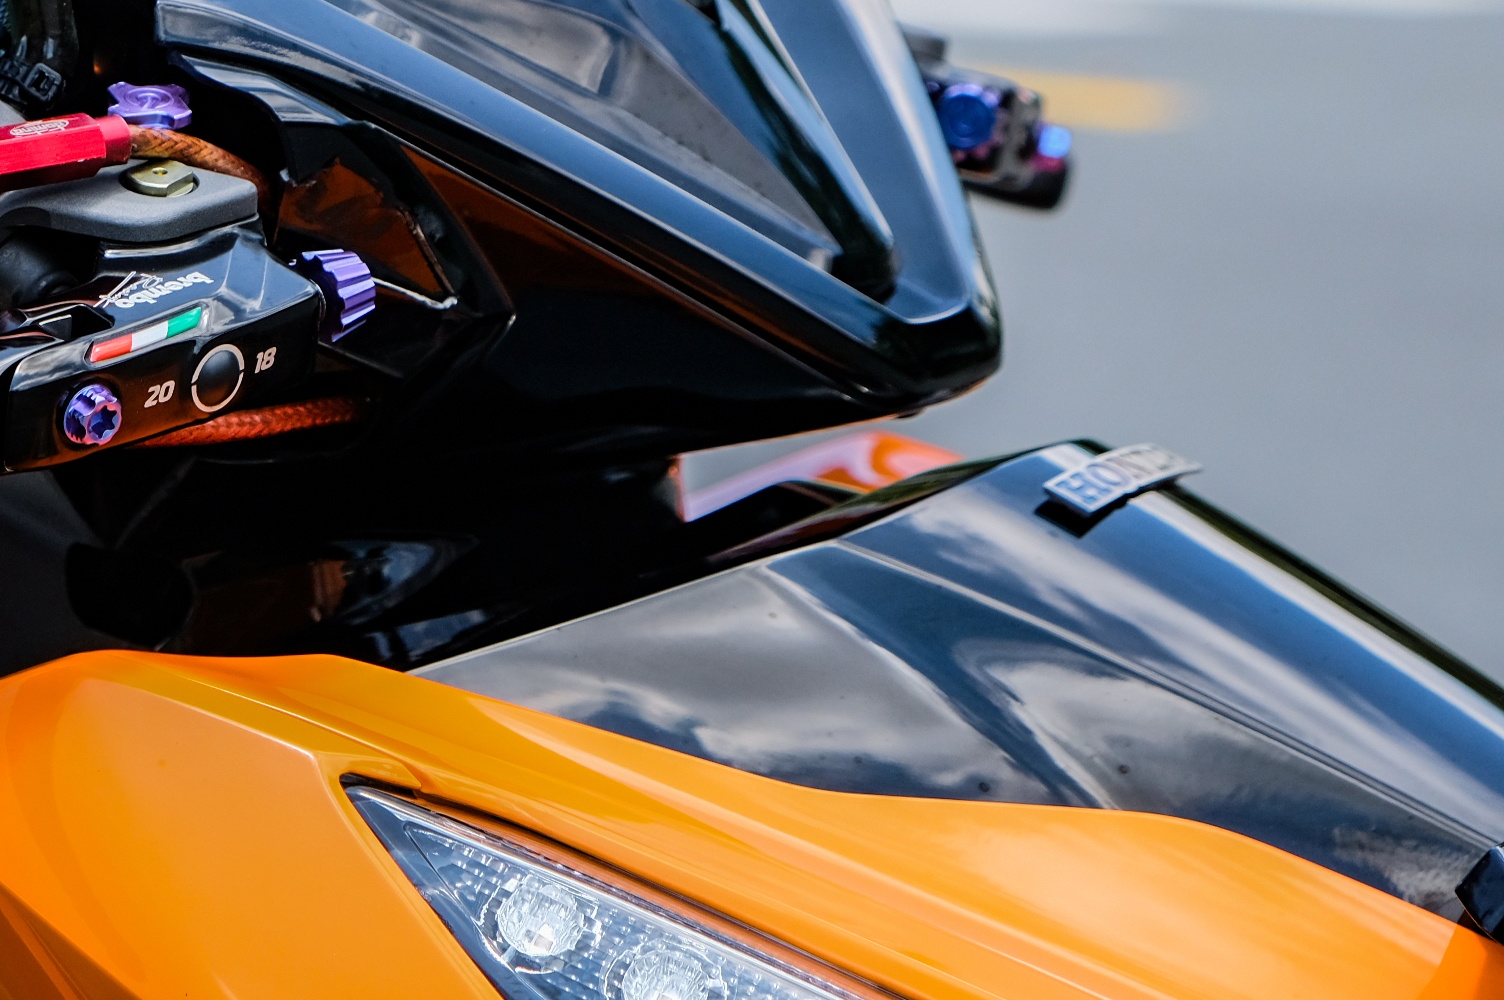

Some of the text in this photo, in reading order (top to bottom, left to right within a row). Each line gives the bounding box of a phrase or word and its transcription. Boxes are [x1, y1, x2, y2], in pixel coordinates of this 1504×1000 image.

[115, 271, 215, 308] brembo
[255, 346, 277, 374] 18
[144, 380, 176, 408] 20
[1049, 448, 1193, 506] HON
